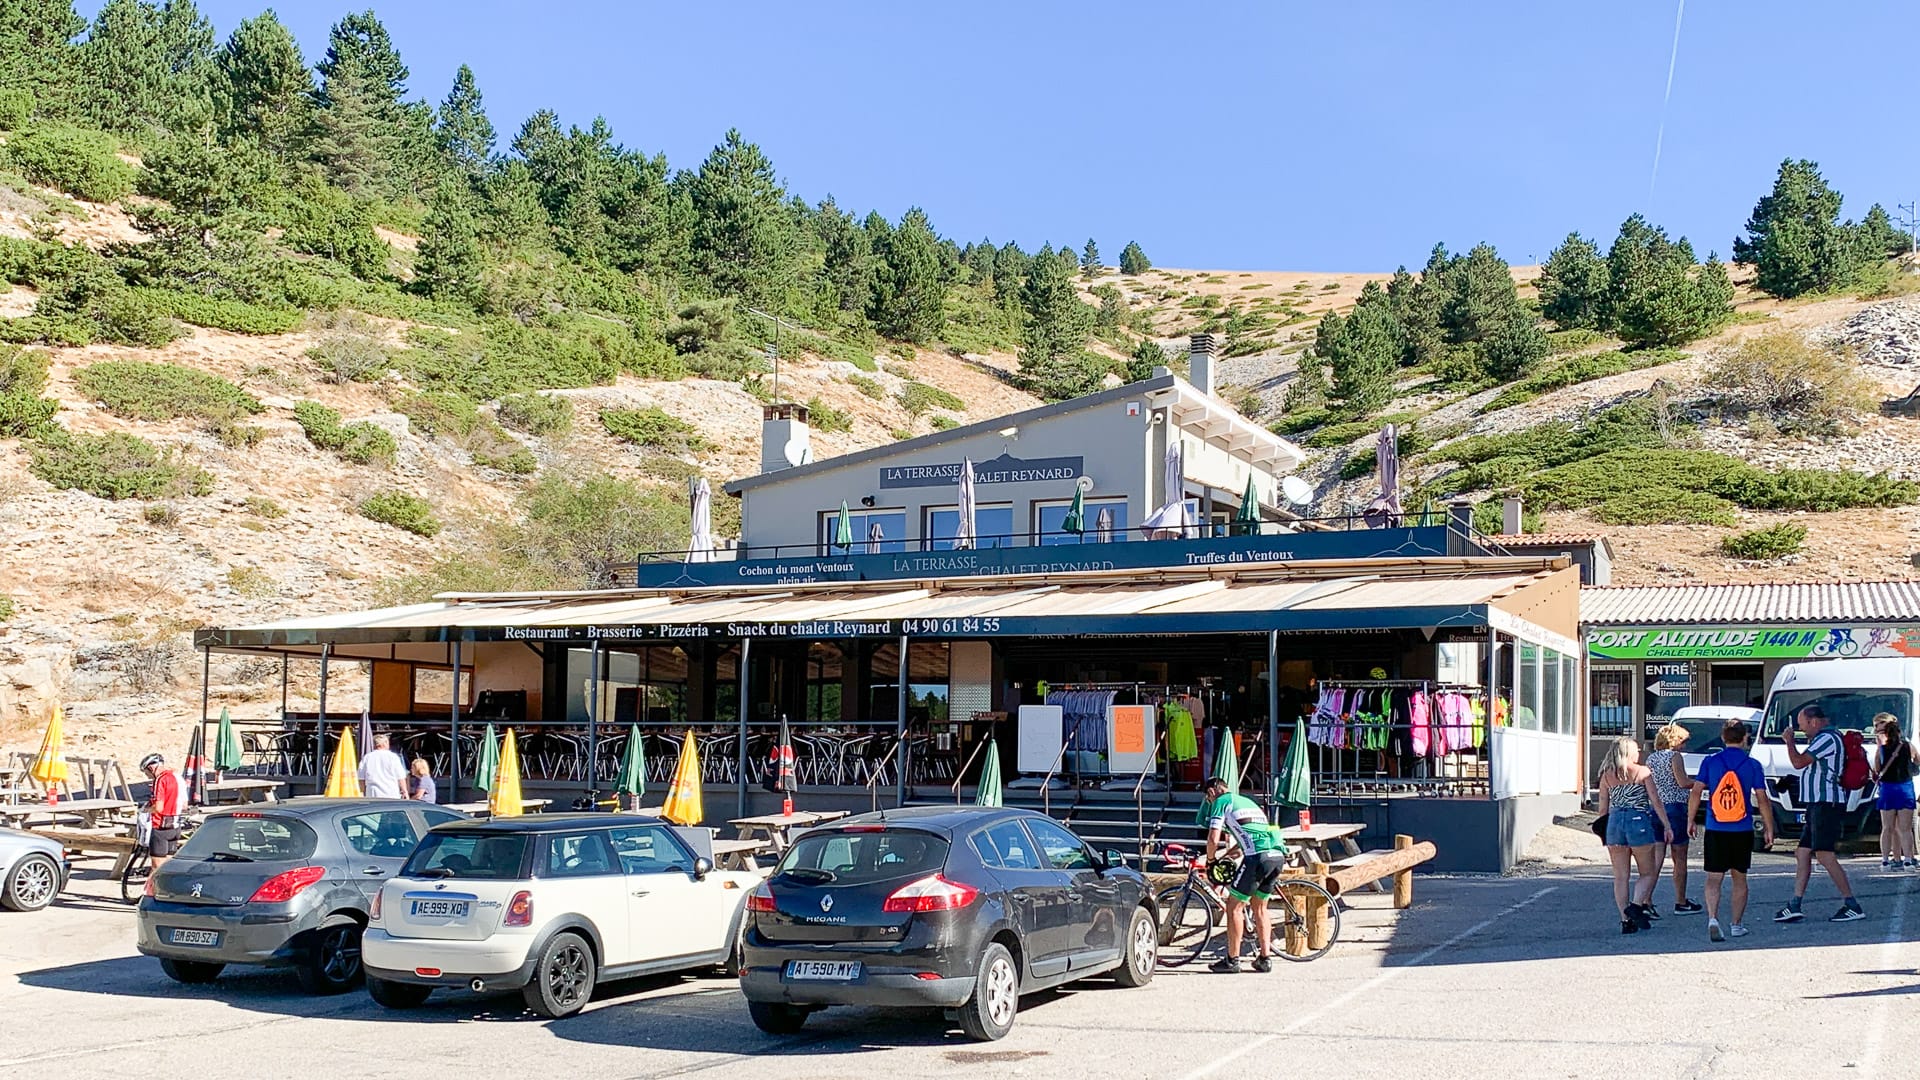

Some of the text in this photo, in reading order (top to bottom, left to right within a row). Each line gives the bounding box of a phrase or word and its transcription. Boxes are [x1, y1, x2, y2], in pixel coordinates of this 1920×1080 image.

[887, 465, 960, 480] LA TERRASSE
[1011, 467, 1074, 481] REYNARD
[893, 556, 978, 572] LA TERRASSE
[1186, 550, 1294, 564] Truffes du Ventoux
[739, 562, 854, 576] Cochon du mont Ventoux
[979, 564, 1038, 576] CHALET
[1040, 560, 1114, 574] REYNARD
[504, 626, 570, 639] Restaurant
[587, 625, 642, 638] Brasserie
[659, 624, 709, 637] Pizzéria
[727, 622, 767, 636] Snack
[769, 622, 787, 635] du
[790, 620, 829, 635] chalet
[833, 620, 891, 637] Reynard
[902, 620, 919, 633] 04
[922, 619, 938, 633] 90
[942, 618, 958, 633] 61
[962, 617, 979, 632] 84
[983, 617, 1000, 632] 55
[1449, 634, 1489, 642] Restauran
[1587, 630, 1817, 648] PORT ALTITUDE 1440 M
[1646, 648, 1753, 657] CHALET REYNARD
